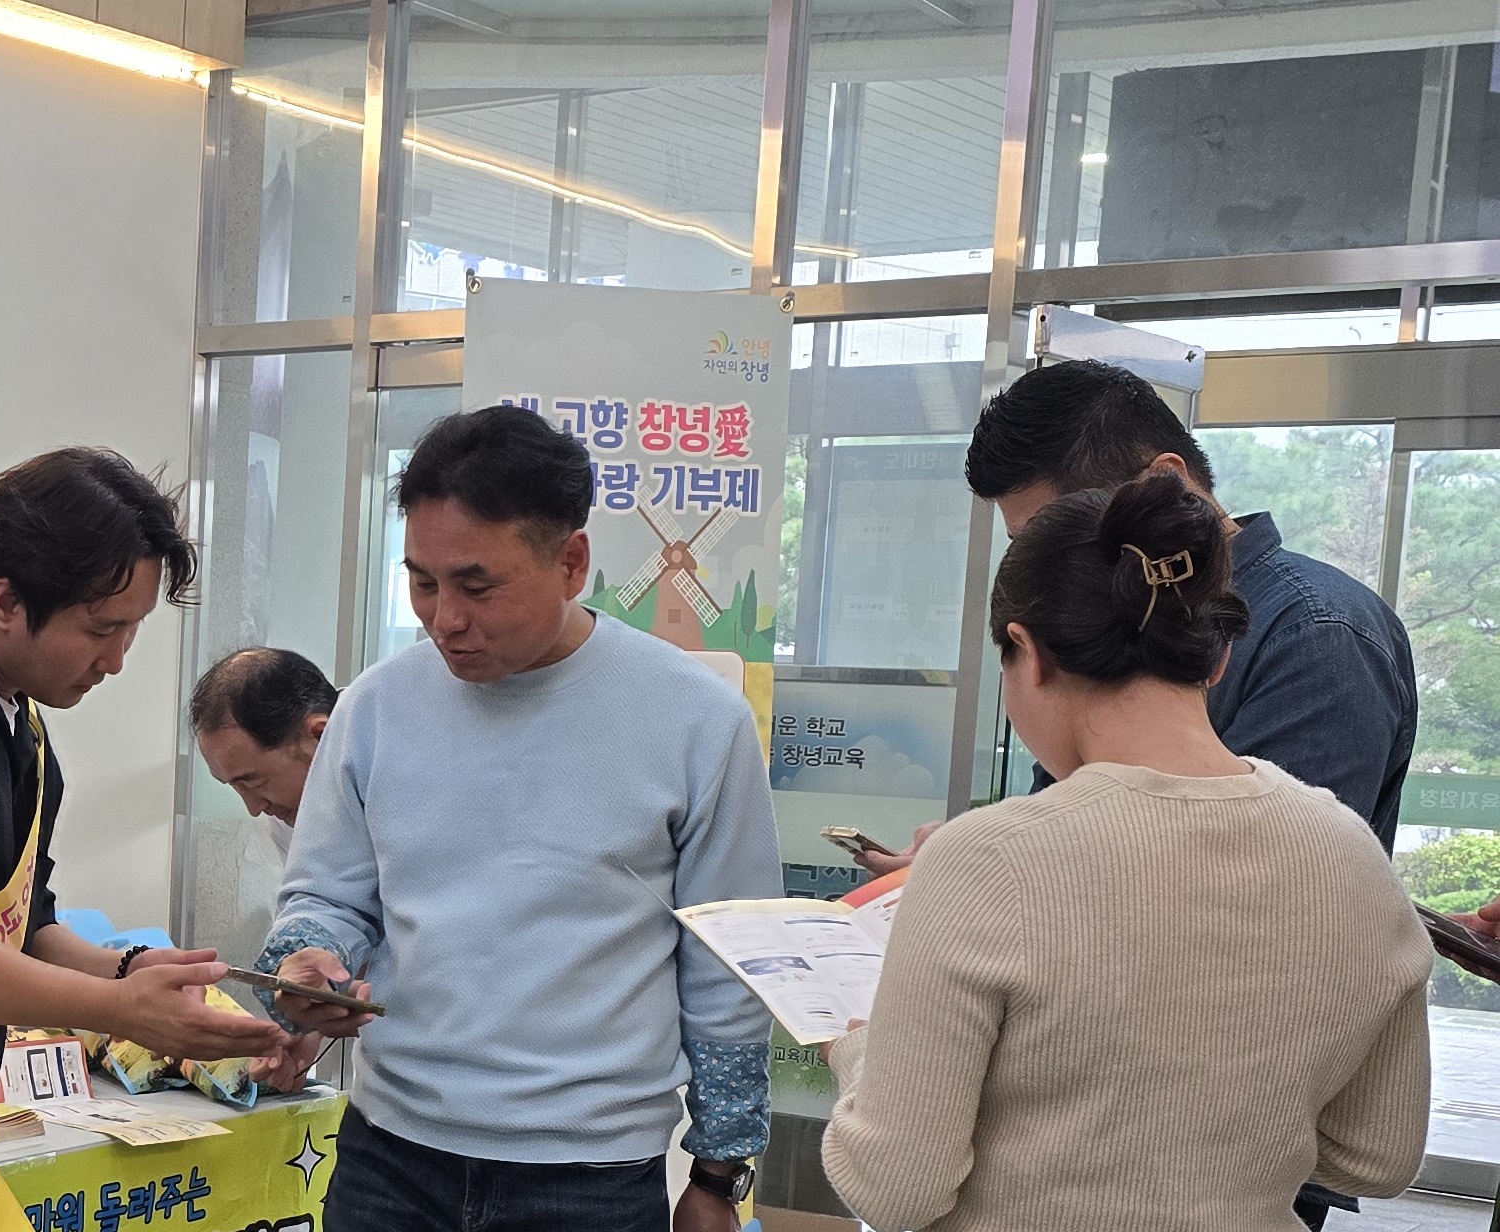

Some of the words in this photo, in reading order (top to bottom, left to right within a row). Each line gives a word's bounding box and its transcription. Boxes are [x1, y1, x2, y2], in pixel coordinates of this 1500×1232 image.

[742, 338, 771, 358] 안녕
[703, 359, 738, 374] 자연의
[741, 361, 770, 382] 창녕
[555, 399, 629, 449] 고향
[638, 402, 750, 458] 창녕愛
[651, 464, 759, 513] 기부제
[806, 716, 846, 738] 학교
[782, 744, 866, 770] 창녕교육
